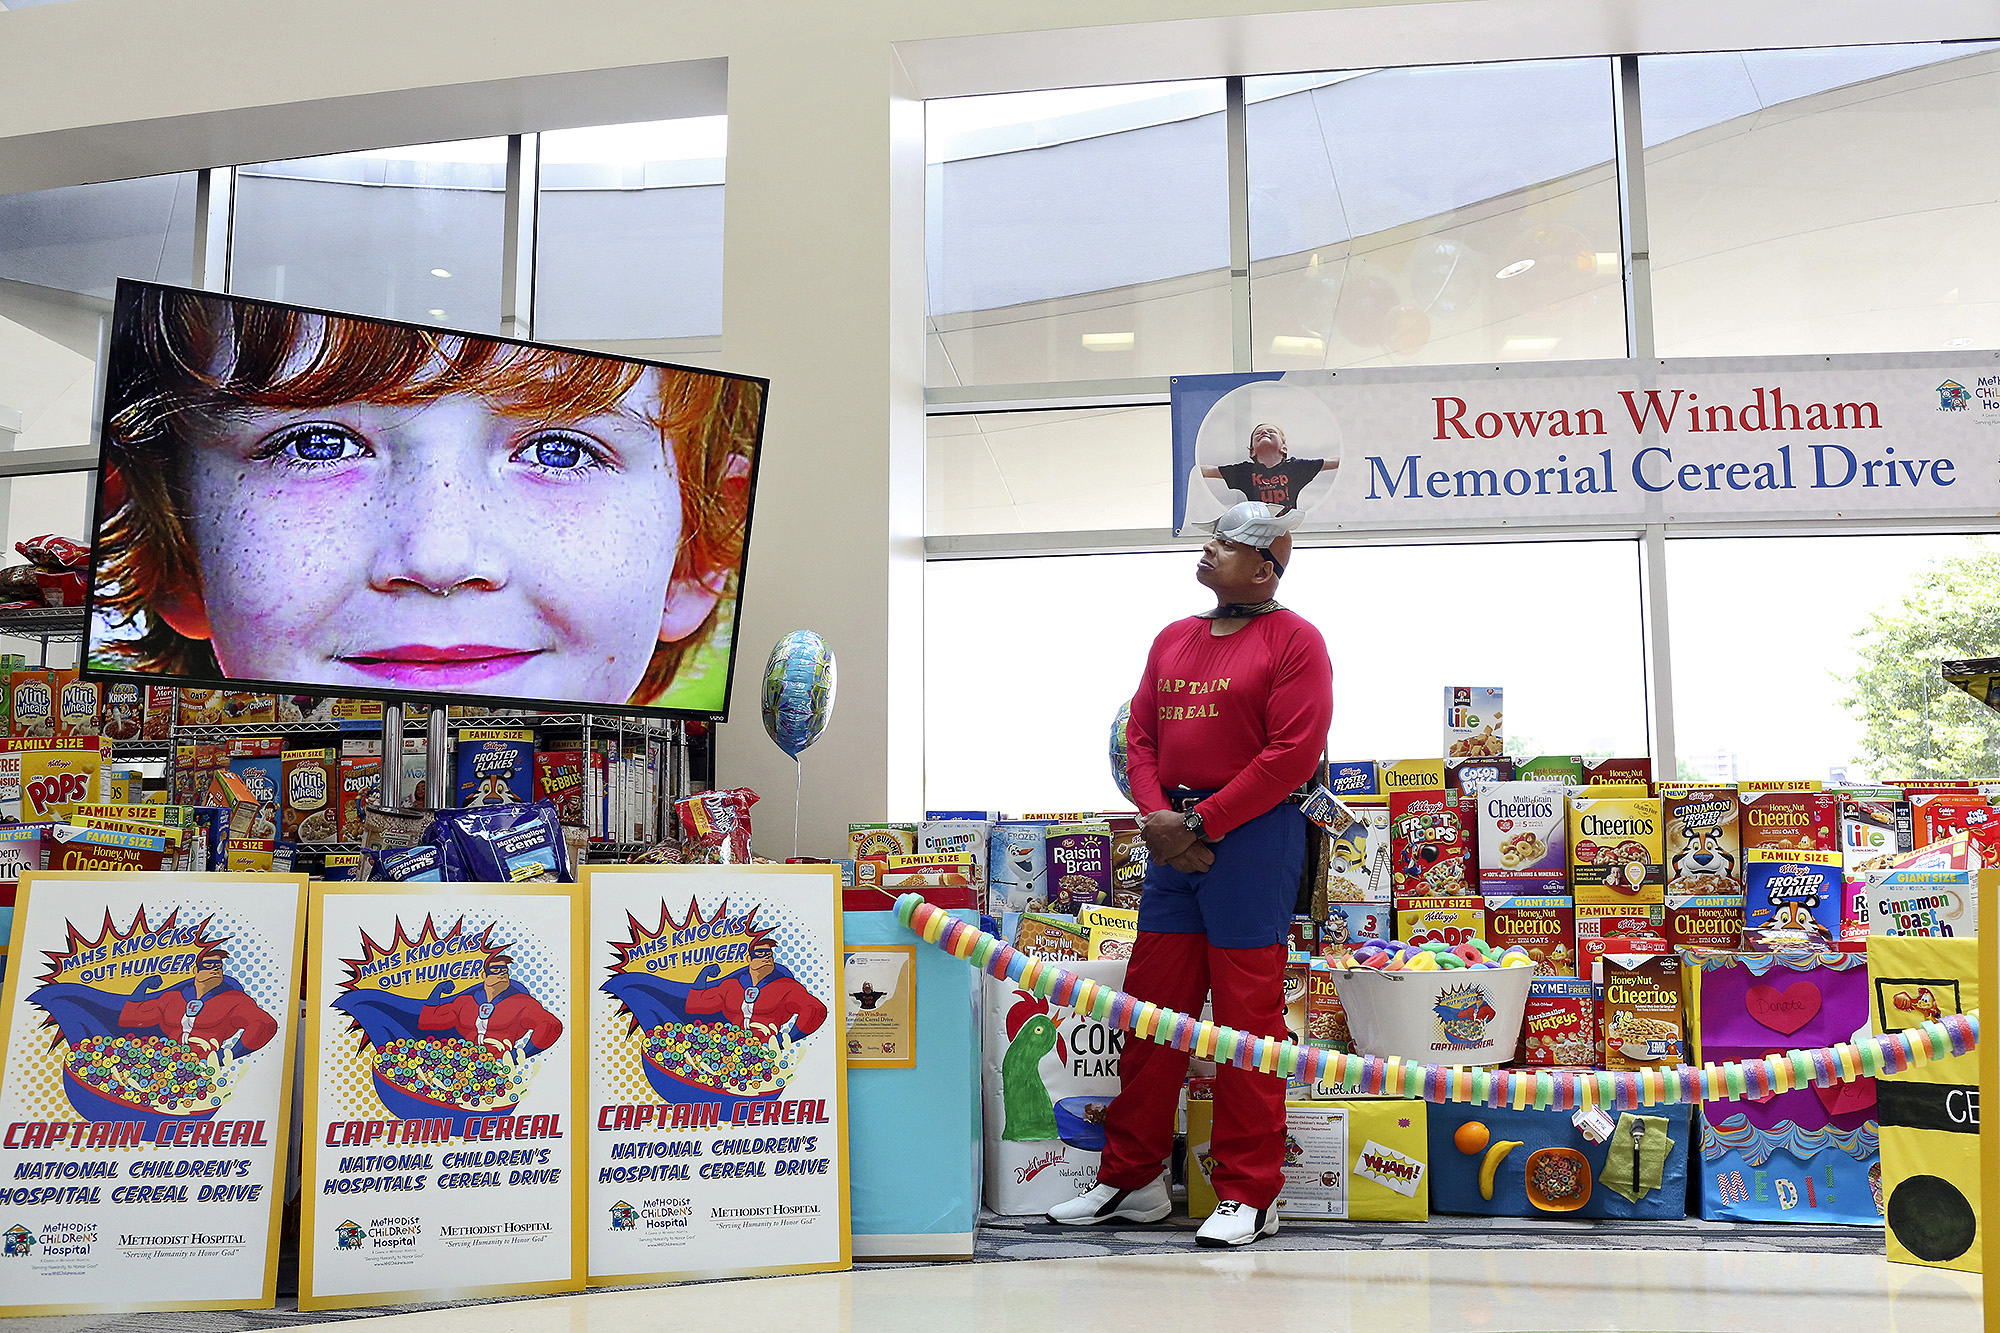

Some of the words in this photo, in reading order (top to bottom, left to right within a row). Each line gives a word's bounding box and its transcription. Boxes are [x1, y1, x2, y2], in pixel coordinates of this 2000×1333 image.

[1432, 396, 1607, 441] Rowan
[1618, 387, 1882, 435] Windham
[1252, 473, 1288, 486] Keep
[1365, 448, 1617, 500] Memorial
[1631, 445, 1796, 493] Cereal
[1808, 444, 1956, 489] Drive
[1261, 486, 1290, 504] up!
[1158, 678, 1232, 694] CAPTAIN
[17, 687, 48, 704] Mini
[64, 687, 94, 704] Mini
[108, 692, 138, 704] KRISPIES
[17, 702, 48, 718] Wheats
[63, 702, 94, 718] Wheats
[1158, 704, 1219, 720] CEREAL
[1448, 708, 1480, 728] life
[470, 731, 501, 740] FAMILY
[504, 731, 523, 740] SIZE
[8, 739, 53, 750] FAMILY
[56, 738, 84, 749] SIZE
[473, 749, 518, 764] FROSTED
[475, 759, 514, 772] FLAKES
[1610, 769, 1630, 778] Honey
[1632, 770, 1644, 778] Nut
[246, 778, 264, 788] RICE
[292, 773, 322, 788] Mini
[1334, 774, 1368, 787] FROSTED
[1336, 780, 1364, 792] FLAKES
[1385, 770, 1438, 788] Cheerios
[1749, 782, 1786, 790] FAMILY
[1788, 782, 1812, 790] SIZE
[26, 773, 88, 816] POPS
[292, 786, 323, 800] Wheats
[1666, 790, 1686, 798] NEW!
[78, 806, 124, 818] FAMILY
[128, 808, 156, 818] SIZE
[1488, 799, 1552, 818] Cheerios
[1674, 801, 1731, 818] CINNAMON
[1770, 803, 1791, 813] Honey
[1792, 803, 1806, 811] Nut
[1400, 813, 1450, 834] FROOT
[1683, 811, 1720, 822] FROSTED
[1686, 818, 1718, 828] FLAKES
[1748, 809, 1810, 827] Cheerios
[1581, 814, 1654, 836] Cheerios
[86, 832, 124, 845] FAMILY
[128, 838, 152, 848] SIZE
[925, 833, 976, 848] Cinnamon
[1409, 827, 1457, 844] LOOPS
[1847, 824, 1885, 847] life
[93, 846, 120, 859] Honey
[124, 850, 140, 860] Nut
[505, 836, 546, 854] Gems
[62, 850, 144, 871] Cheerios
[901, 856, 935, 865] FAMILY
[938, 854, 960, 862] SIZE
[1054, 846, 1101, 864] Raisin
[1761, 851, 1802, 862] FAMILY
[1805, 853, 1828, 862] SIZE
[1066, 860, 1102, 874] Bran
[1766, 874, 1824, 890] FROSTED
[1898, 874, 1932, 883] GIANT
[1935, 874, 1956, 882] SIZE
[1769, 884, 1819, 898] FLAKES
[1409, 900, 1446, 908] FAMILY
[1450, 899, 1472, 908] SIZE
[1515, 898, 1544, 906] GIANT
[1545, 898, 1564, 906] SIZE
[1879, 894, 1950, 914] Cinnamon
[1424, 911, 1458, 923] Kellogg's
[1518, 909, 1541, 919] Honey
[1543, 909, 1556, 918] Nut
[1580, 908, 1616, 916] FAMILY
[1698, 908, 1721, 918] Honey
[1724, 908, 1738, 917] Nut
[1892, 910, 1938, 930] Toast
[1364, 914, 1377, 932] 3
[1494, 914, 1562, 936] Cheerios
[1578, 922, 1599, 933] FREE
[1674, 914, 1742, 934] Cheerios
[630, 940, 668, 960] MHS
[672, 916, 748, 946] KNOCKS
[1036, 934, 1059, 948] Honey
[1060, 938, 1072, 948] Nut
[1712, 936, 1731, 944] OATS
[62, 945, 108, 973] MHS
[112, 924, 201, 957] KNOCKS
[1588, 942, 1603, 951] Post
[362, 957, 400, 978] MHS
[405, 933, 484, 964] KNOCKS
[646, 956, 678, 972] OUT
[682, 942, 748, 966] HUNGER
[79, 963, 117, 985] OUT
[121, 952, 197, 980] HUNGER
[379, 972, 411, 989] OUT
[415, 959, 483, 984] HUNGER
[1611, 976, 1636, 986] Honey
[1637, 976, 1652, 984] Nut
[1608, 984, 1678, 1004] Cheerios
[1528, 1007, 1566, 1022] Marshmallow
[1758, 998, 1806, 1015] Donate
[1529, 1012, 1578, 1034] Mateys
[1430, 1042, 1466, 1051] CAPTAIN
[1468, 1039, 1494, 1050] CEREAL
[598, 1102, 721, 1132] CAPTAIN
[731, 1099, 830, 1126] CEREAL
[2, 1121, 147, 1150] CAPTAIN
[153, 1119, 268, 1147] CEREAL
[325, 1116, 452, 1147] CAPTAIN
[463, 1114, 564, 1142] CEREAL
[610, 1140, 702, 1160] NATIONAL
[711, 1136, 818, 1156] CHILDREN'S
[339, 1153, 434, 1173] NATIONAL
[442, 1148, 550, 1168] CHILDREN'S
[1363, 1152, 1421, 1181] WHAM!
[13, 1160, 118, 1181] NATIONAL
[128, 1158, 252, 1179] CHILDREN'S
[598, 1164, 690, 1184] HOSPITAL
[699, 1160, 767, 1180] CEREAL
[774, 1158, 830, 1176] DRIVE
[1060, 1166, 1084, 1177] National
[323, 1174, 426, 1194] HOSPITALS
[437, 1172, 502, 1190] CEREAL
[509, 1168, 562, 1186] DRIVE
[1717, 1165, 1836, 1211] MEDI!
[0, 1186, 101, 1206] HOSPITAL
[111, 1185, 188, 1204] CEREAL
[197, 1184, 263, 1203] DRIVE
[710, 1206, 770, 1218] METHODIST
[773, 1204, 820, 1215] HOSPITAL
[440, 1225, 500, 1237] METHODIST
[504, 1222, 552, 1234] HOSPITAL
[646, 1218, 688, 1230] Hospital
[118, 1234, 188, 1246] METHODIST
[191, 1232, 246, 1244] HOSPITAL
[373, 1236, 416, 1249] Hospital
[43, 1243, 90, 1256] Hospital
